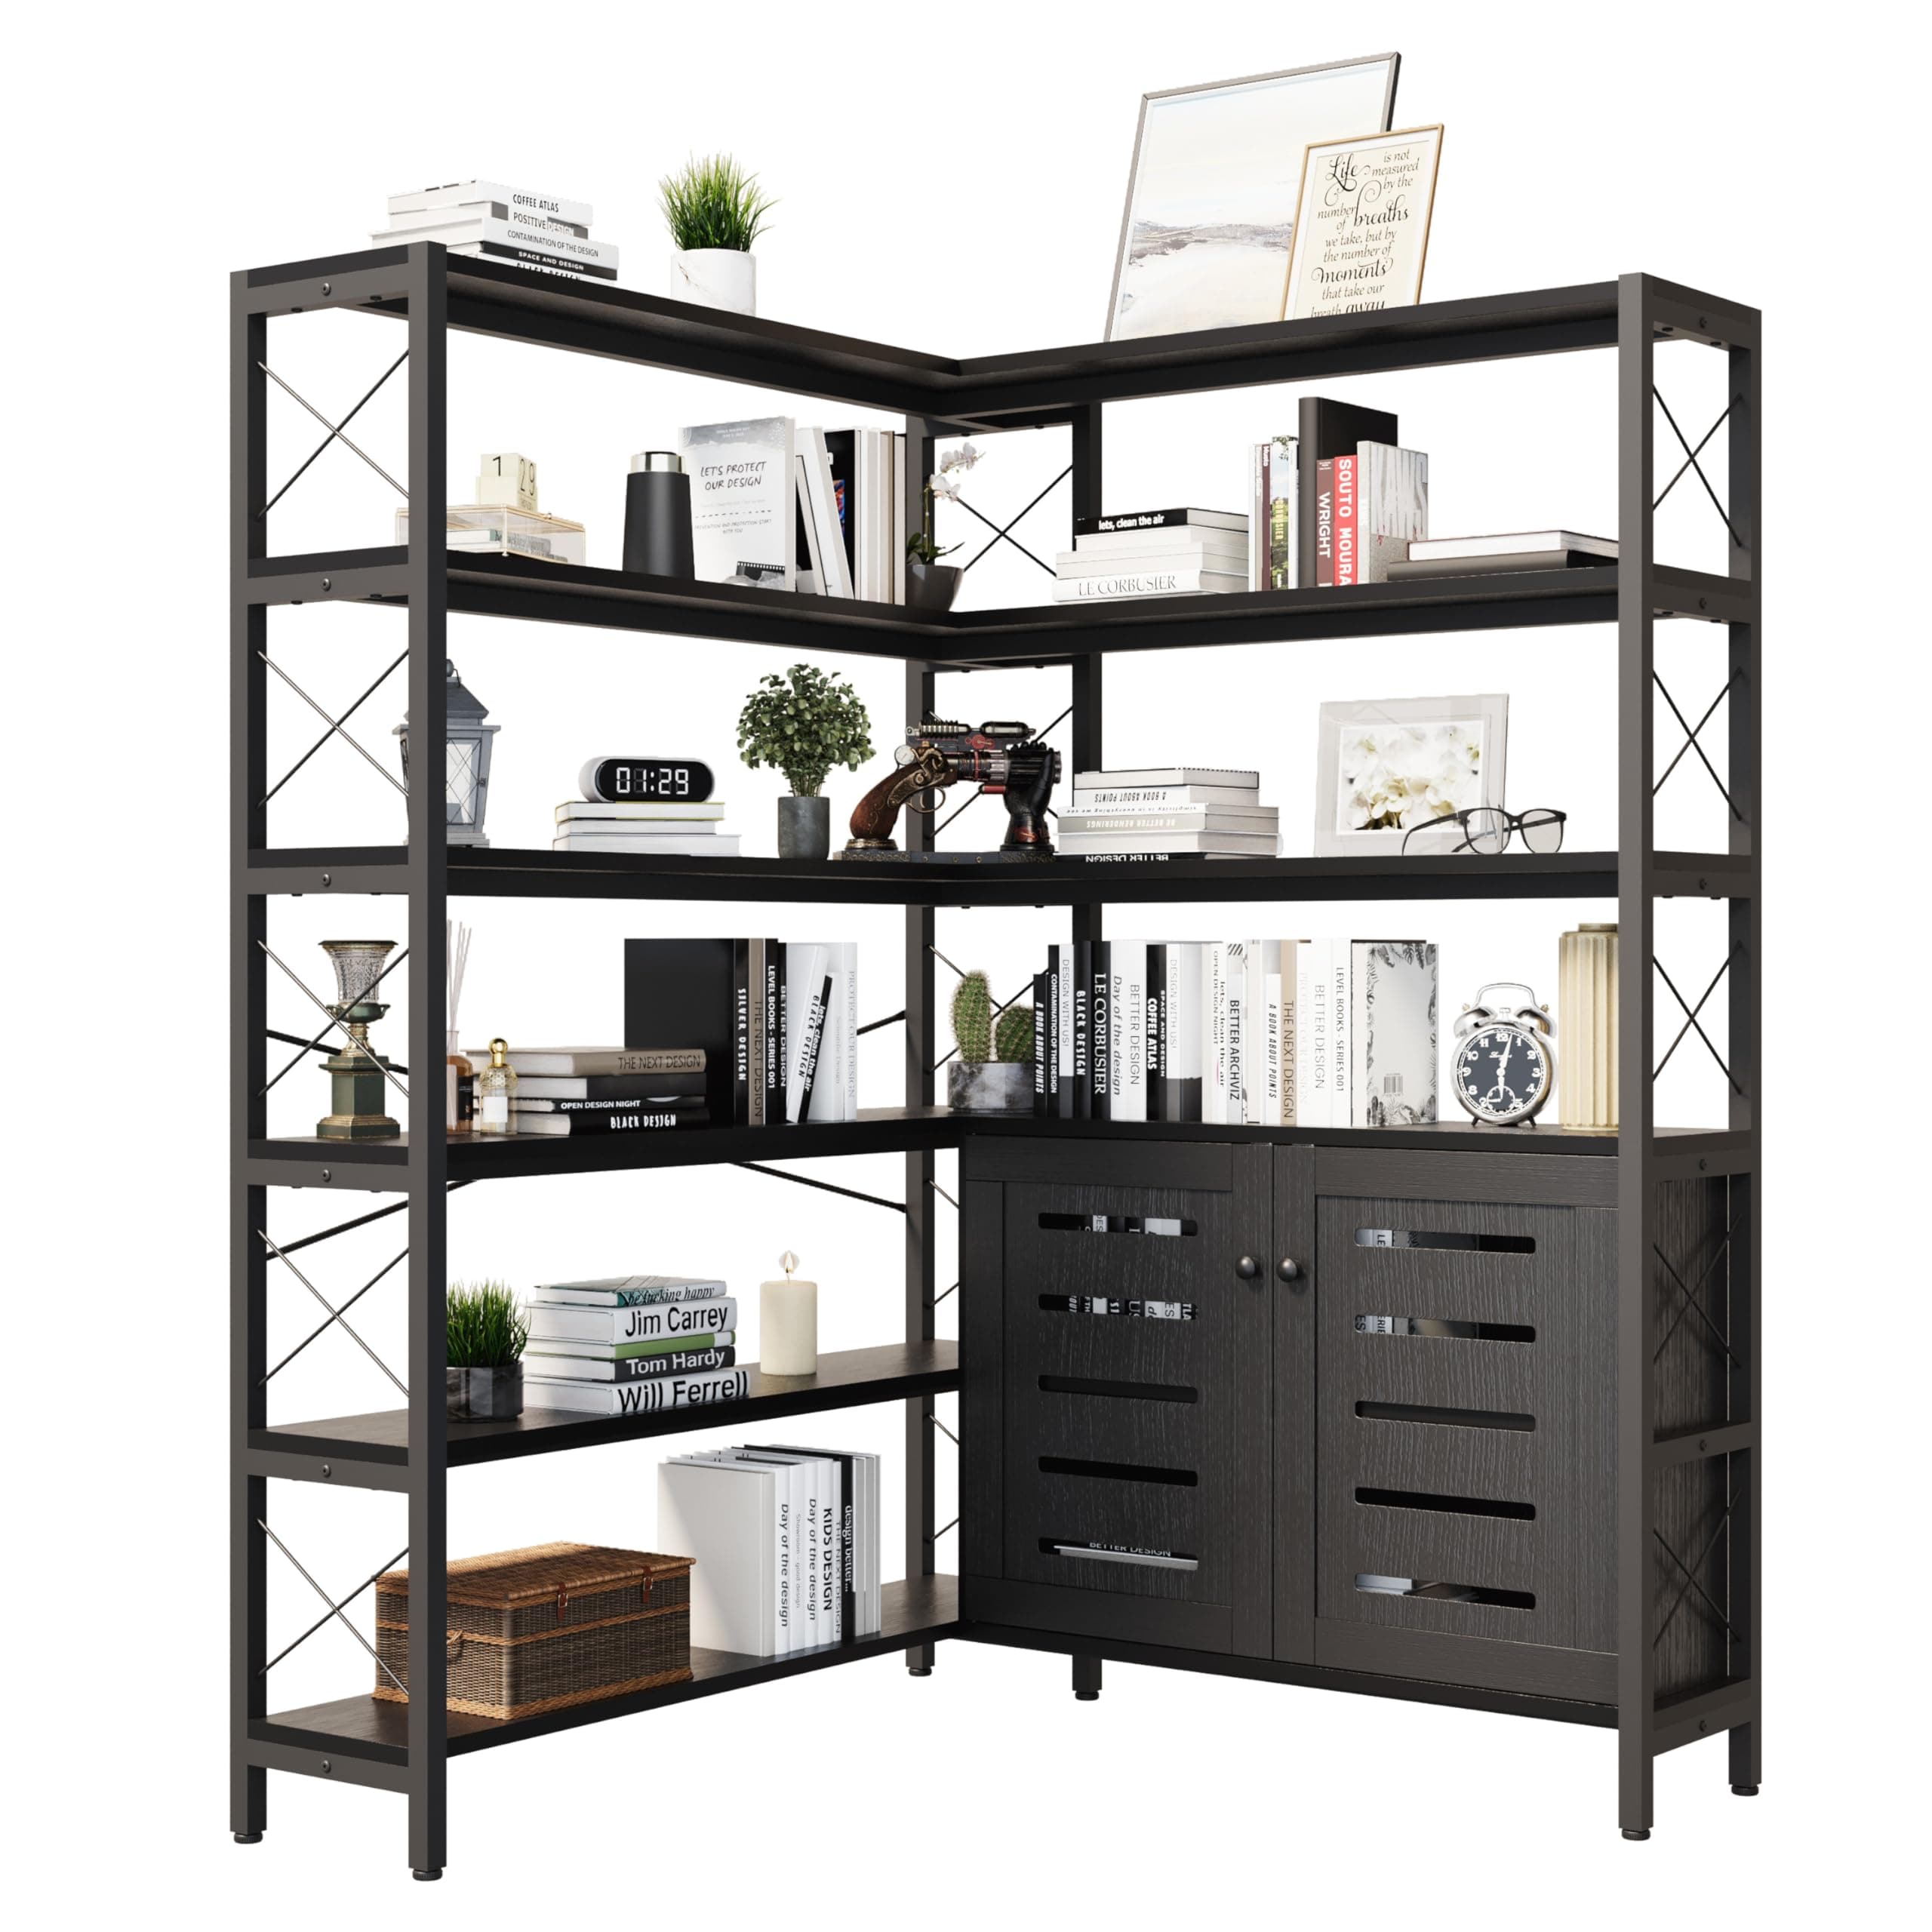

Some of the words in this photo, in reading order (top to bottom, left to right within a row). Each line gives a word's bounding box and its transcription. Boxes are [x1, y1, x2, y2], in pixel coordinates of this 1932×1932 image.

[1372, 158, 1420, 176] measured
[1384, 151, 1392, 163] is
[1395, 149, 1411, 161] not
[1325, 153, 1371, 193] Life
[1384, 178, 1395, 193] by
[1398, 174, 1414, 188] the
[513, 194, 537, 208] COFFEE
[539, 200, 559, 213] ATLAS
[1318, 202, 1356, 219] number
[1337, 216, 1350, 234] of
[1354, 189, 1408, 226] breaths
[513, 212, 546, 229] POSITIVE
[508, 229, 556, 248] CONTAMINATION
[557, 241, 565, 251] OF
[566, 243, 577, 253] THE
[577, 246, 598, 257] DESIGN
[1325, 237, 1339, 248] we
[1366, 229, 1382, 243] but
[1385, 227, 1398, 242] by
[518, 251, 540, 261] SPACE
[542, 255, 557, 265] AND
[558, 258, 584, 271] DESIGN
[1324, 249, 1339, 263] the
[1341, 245, 1380, 260] number
[1382, 240, 1395, 258] of
[1312, 260, 1393, 283] moments
[1322, 286, 1342, 300] that
[1344, 282, 1365, 297] take
[1367, 285, 1385, 294] our
[493, 455, 501, 477] 1
[519, 458, 535, 496] 29
[700, 466, 723, 478] LET'S
[726, 461, 767, 475] PROTECT
[705, 479, 724, 491] OUR
[728, 475, 762, 489] DESIGN
[1339, 459, 1352, 518] SOUTO
[1098, 519, 1115, 531] lets,
[1116, 517, 1137, 529] clean
[1138, 515, 1152, 526] the
[1152, 514, 1164, 525] air
[1318, 492, 1331, 558] WRIGHT
[1339, 528, 1352, 586] MOURA
[1078, 582, 1095, 596] LE
[1097, 574, 1177, 595] CORBUSIER
[616, 767, 689, 795] 01:29
[1094, 792, 1117, 803] POINTS
[1120, 792, 1140, 801] ABOUT
[1143, 791, 1159, 801] BOOK
[1087, 820, 1134, 828] RENDERINGS
[1085, 854, 1127, 863] DESIGN
[1094, 974, 1106, 994] LE
[1113, 976, 1122, 1002] Day
[1336, 967, 1344, 995] LEVEL
[737, 988, 746, 1030] SILVER
[808, 995, 820, 1030] BLACK
[1076, 990, 1086, 1027] BLACK
[1113, 1006, 1122, 1021] of
[1130, 984, 1140, 1031] BETTER
[1147, 998, 1158, 1035] COFFEE
[1284, 1001, 1294, 1026] THE
[1315, 985, 1324, 1033] BETTER
[1336, 998, 1344, 1032] BOOKS
[1035, 1011, 1044, 1032] BOOK
[1113, 1024, 1122, 1046] the
[1229, 1000, 1240, 1044] BETTER
[1269, 1013, 1277, 1035] BOOK
[811, 1029, 821, 1057] clean
[1035, 1035, 1044, 1062] ABOUT
[1051, 1038, 1057, 1049] OF
[1076, 1033, 1086, 1075] DESIGN
[1094, 998, 1106, 1094] CORBUSIER
[1147, 1041, 1158, 1070] ATLAS
[1269, 1038, 1277, 1065] ABOUT
[1284, 1029, 1294, 1063] NEXT
[1336, 1040, 1344, 1072] SERIES
[618, 1057, 636, 1069] THE
[638, 1056, 663, 1069] NEXT
[666, 1055, 701, 1068] DESIGN
[737, 1036, 746, 1081] DESIGN
[798, 1036, 812, 1078] DESIGN
[807, 1057, 817, 1078] the
[1130, 1035, 1140, 1084] DESIGN
[1315, 1038, 1324, 1088] DESIGN
[804, 1079, 814, 1092] air
[1035, 1063, 1044, 1093] POINTS
[1113, 1051, 1122, 1097] design
[1229, 1047, 1240, 1100] ARCHVIZ
[1269, 1068, 1277, 1098] POINTS
[1336, 1075, 1344, 1091] 001
[615, 1100, 641, 1108] NIGHT
[1284, 1066, 1294, 1118] DESIGN
[610, 1115, 639, 1129] BLACK
[643, 1114, 676, 1128] DESIGN
[625, 1310, 660, 1337] Jim
[668, 1306, 728, 1333] Carrey
[625, 1358, 666, 1375] Tom
[672, 1349, 725, 1368] Hardy
[617, 1383, 663, 1412] Will
[672, 1371, 749, 1406] Ferrell
[779, 1503, 789, 1531] Day
[807, 1499, 817, 1523] Day
[842, 1505, 853, 1544] design
[807, 1528, 817, 1543] of
[823, 1508, 832, 1546] KIDS
[779, 1534, 789, 1549] of
[779, 1554, 789, 1576] the
[807, 1547, 817, 1570] the
[823, 1550, 832, 1611] DESIGN
[779, 1580, 789, 1627] design
[807, 1574, 817, 1621] design
